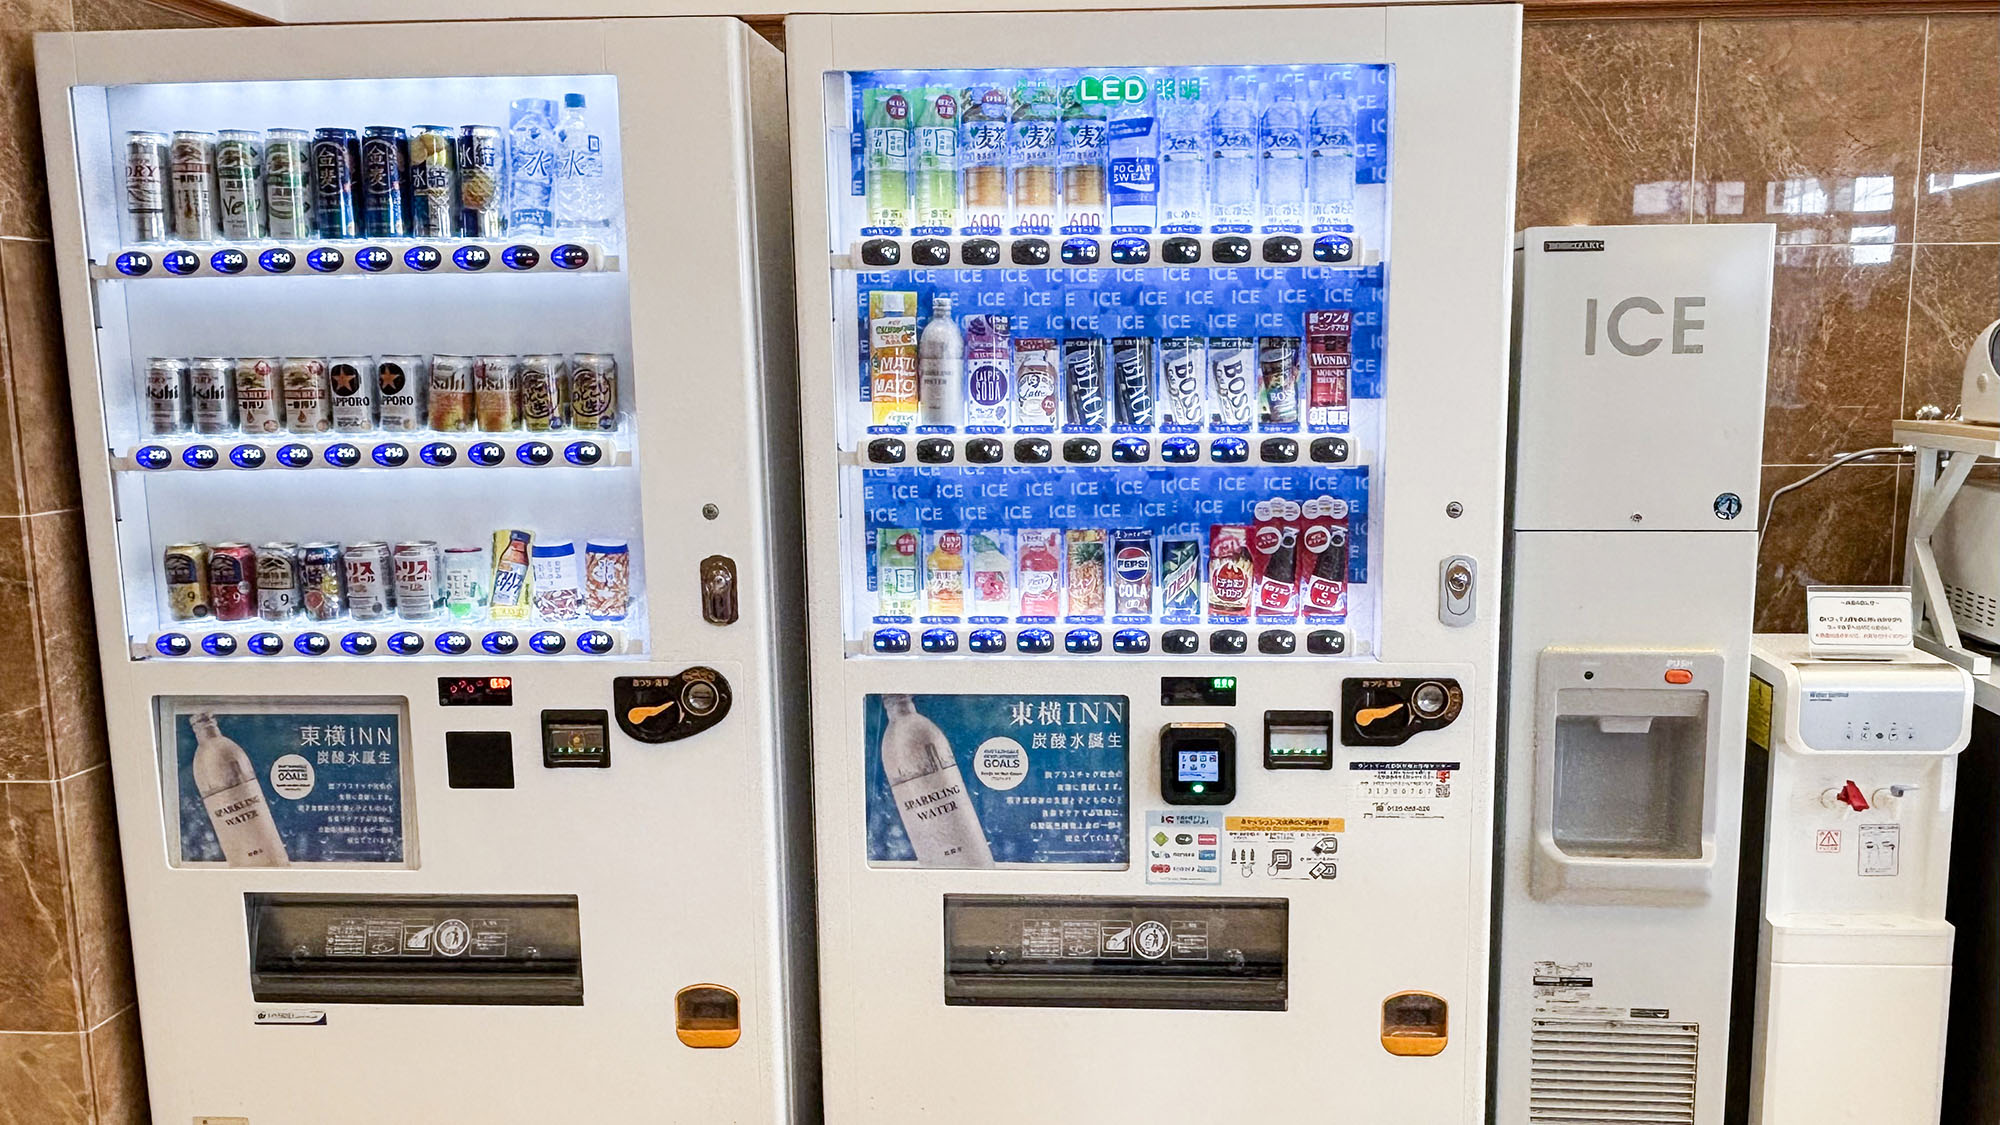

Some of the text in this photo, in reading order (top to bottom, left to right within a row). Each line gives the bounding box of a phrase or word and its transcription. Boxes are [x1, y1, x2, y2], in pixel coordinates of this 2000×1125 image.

[1081, 80, 1144, 101] LED
[523, 150, 552, 176] 水
[562, 149, 586, 179] 水
[1114, 164, 1154, 173] POCARI
[1114, 172, 1152, 182] SWEAT
[1585, 296, 1706, 356] ICE
[1312, 353, 1348, 366] WONDA
[976, 386, 1001, 400] SODA
[1175, 362, 1202, 422] BOSS
[1224, 360, 1250, 423] BOSS
[1117, 559, 1148, 568] PEPSI
[1118, 584, 1148, 598] COLA
[280, 594, 289, 606] 9
[1010, 701, 1122, 726] 東横INN
[300, 725, 392, 746] 東横INN
[1032, 732, 1122, 749] 炭酸水誕生
[317, 750, 391, 765] 炭酸水誕生
[984, 759, 1020, 768] GOALS
[904, 784, 960, 811] SPARKLING
[225, 810, 259, 826] WATER
[917, 801, 958, 821] WATER
